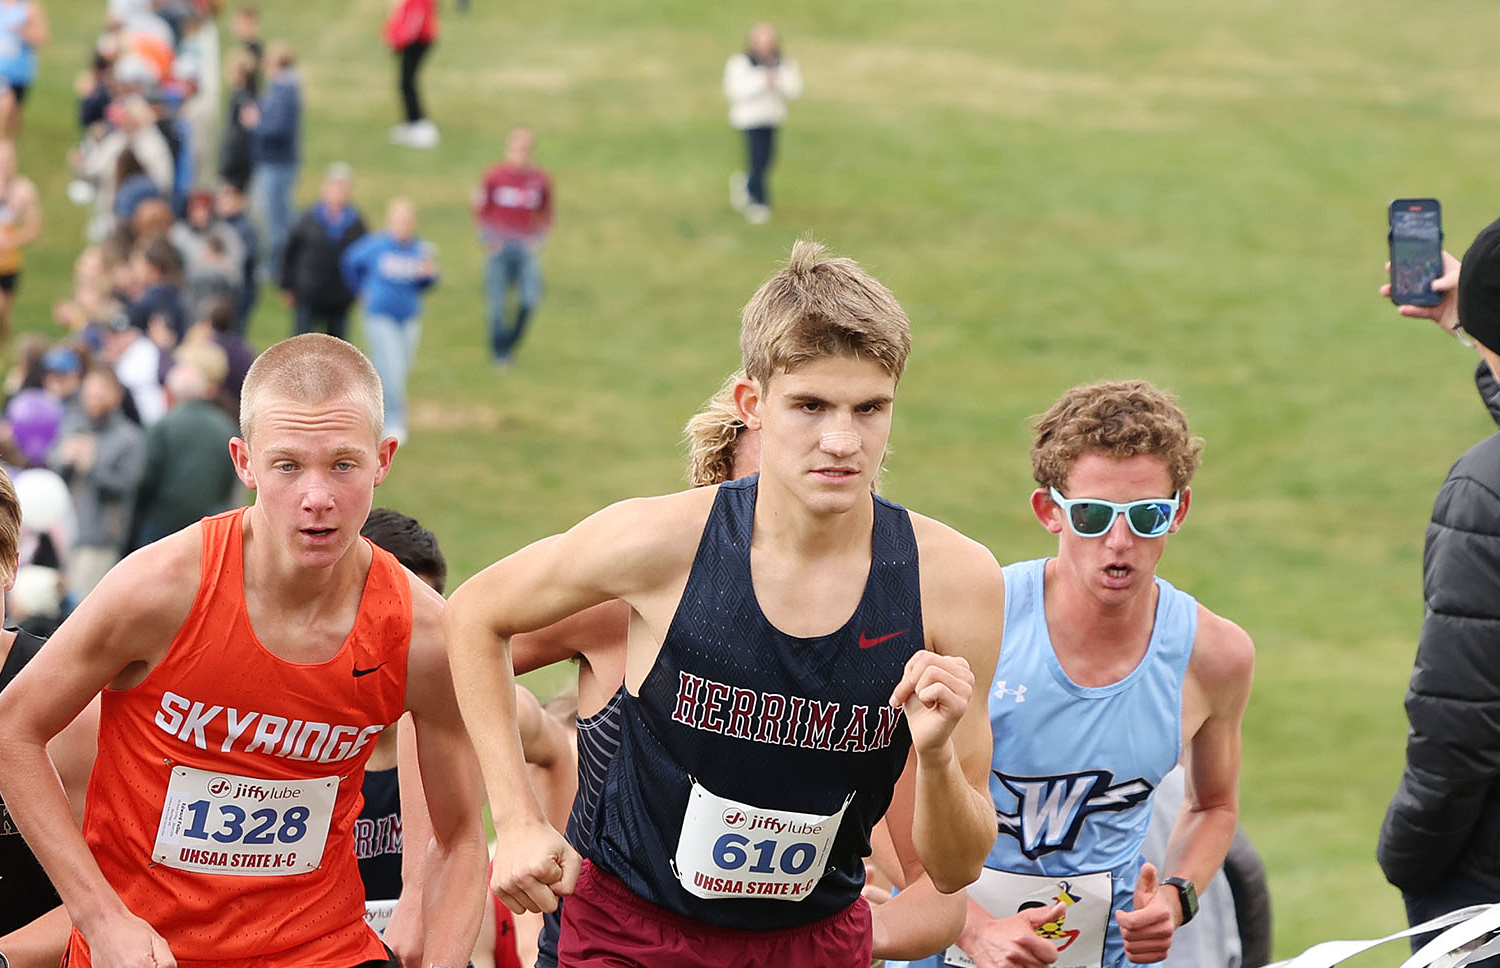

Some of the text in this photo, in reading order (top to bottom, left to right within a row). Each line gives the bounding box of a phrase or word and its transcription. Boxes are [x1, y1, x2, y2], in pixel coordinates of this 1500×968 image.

[153, 690, 386, 764] SKYRIDGE
[670, 669, 904, 753] HERRIMAN
[183, 799, 311, 845] 1328
[179, 847, 297, 868] UHSAA STATE X-C
[712, 832, 817, 875] 610
[693, 871, 744, 894] UHSAA
[745, 879, 790, 895] STATE
